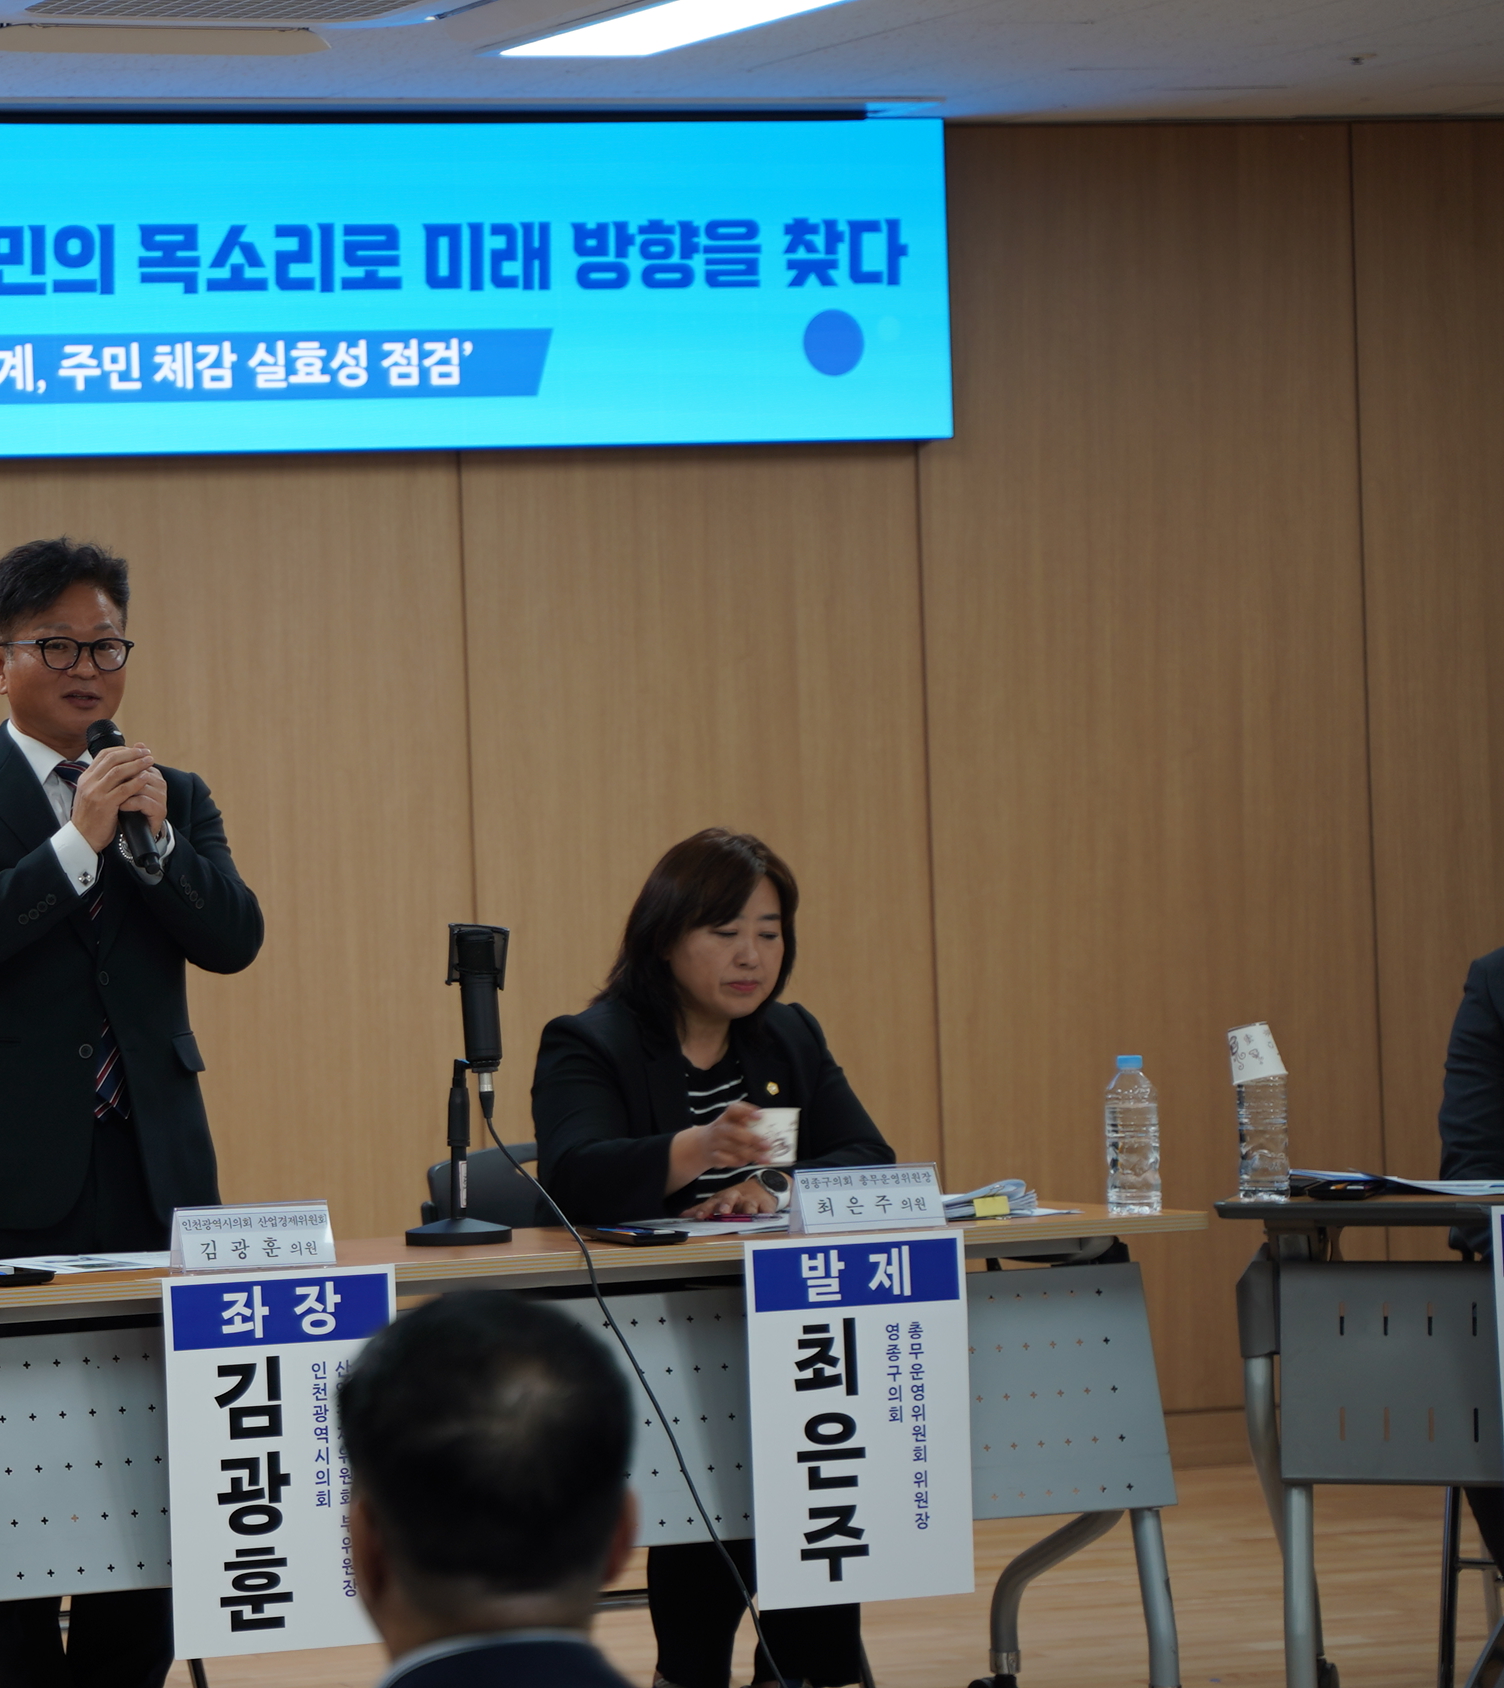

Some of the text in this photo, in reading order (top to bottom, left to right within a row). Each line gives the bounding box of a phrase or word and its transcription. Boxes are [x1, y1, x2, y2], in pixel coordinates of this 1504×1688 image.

[138, 222, 403, 295] 목소리로
[422, 221, 552, 292] 미래
[571, 218, 763, 290] 방향을
[783, 217, 909, 288] 찾다
[58, 341, 143, 391] 주민
[153, 340, 238, 389] 체감
[248, 339, 369, 388] 실효성
[800, 1171, 932, 1190] 영종구의회 총무운영위원장
[901, 1197, 927, 1212] 의원
[181, 1213, 327, 1232] 인천광역시의회 산업경제위원회
[290, 1240, 318, 1256] 의원
[885, 1322, 904, 1424] 영종구의회
[311, 1360, 332, 1508] 인천광역시의회
[794, 1317, 870, 1583] 최은주
[908, 1321, 930, 1531] 총무운영위원회 위원장
[214, 1355, 294, 1633] 김광훈
